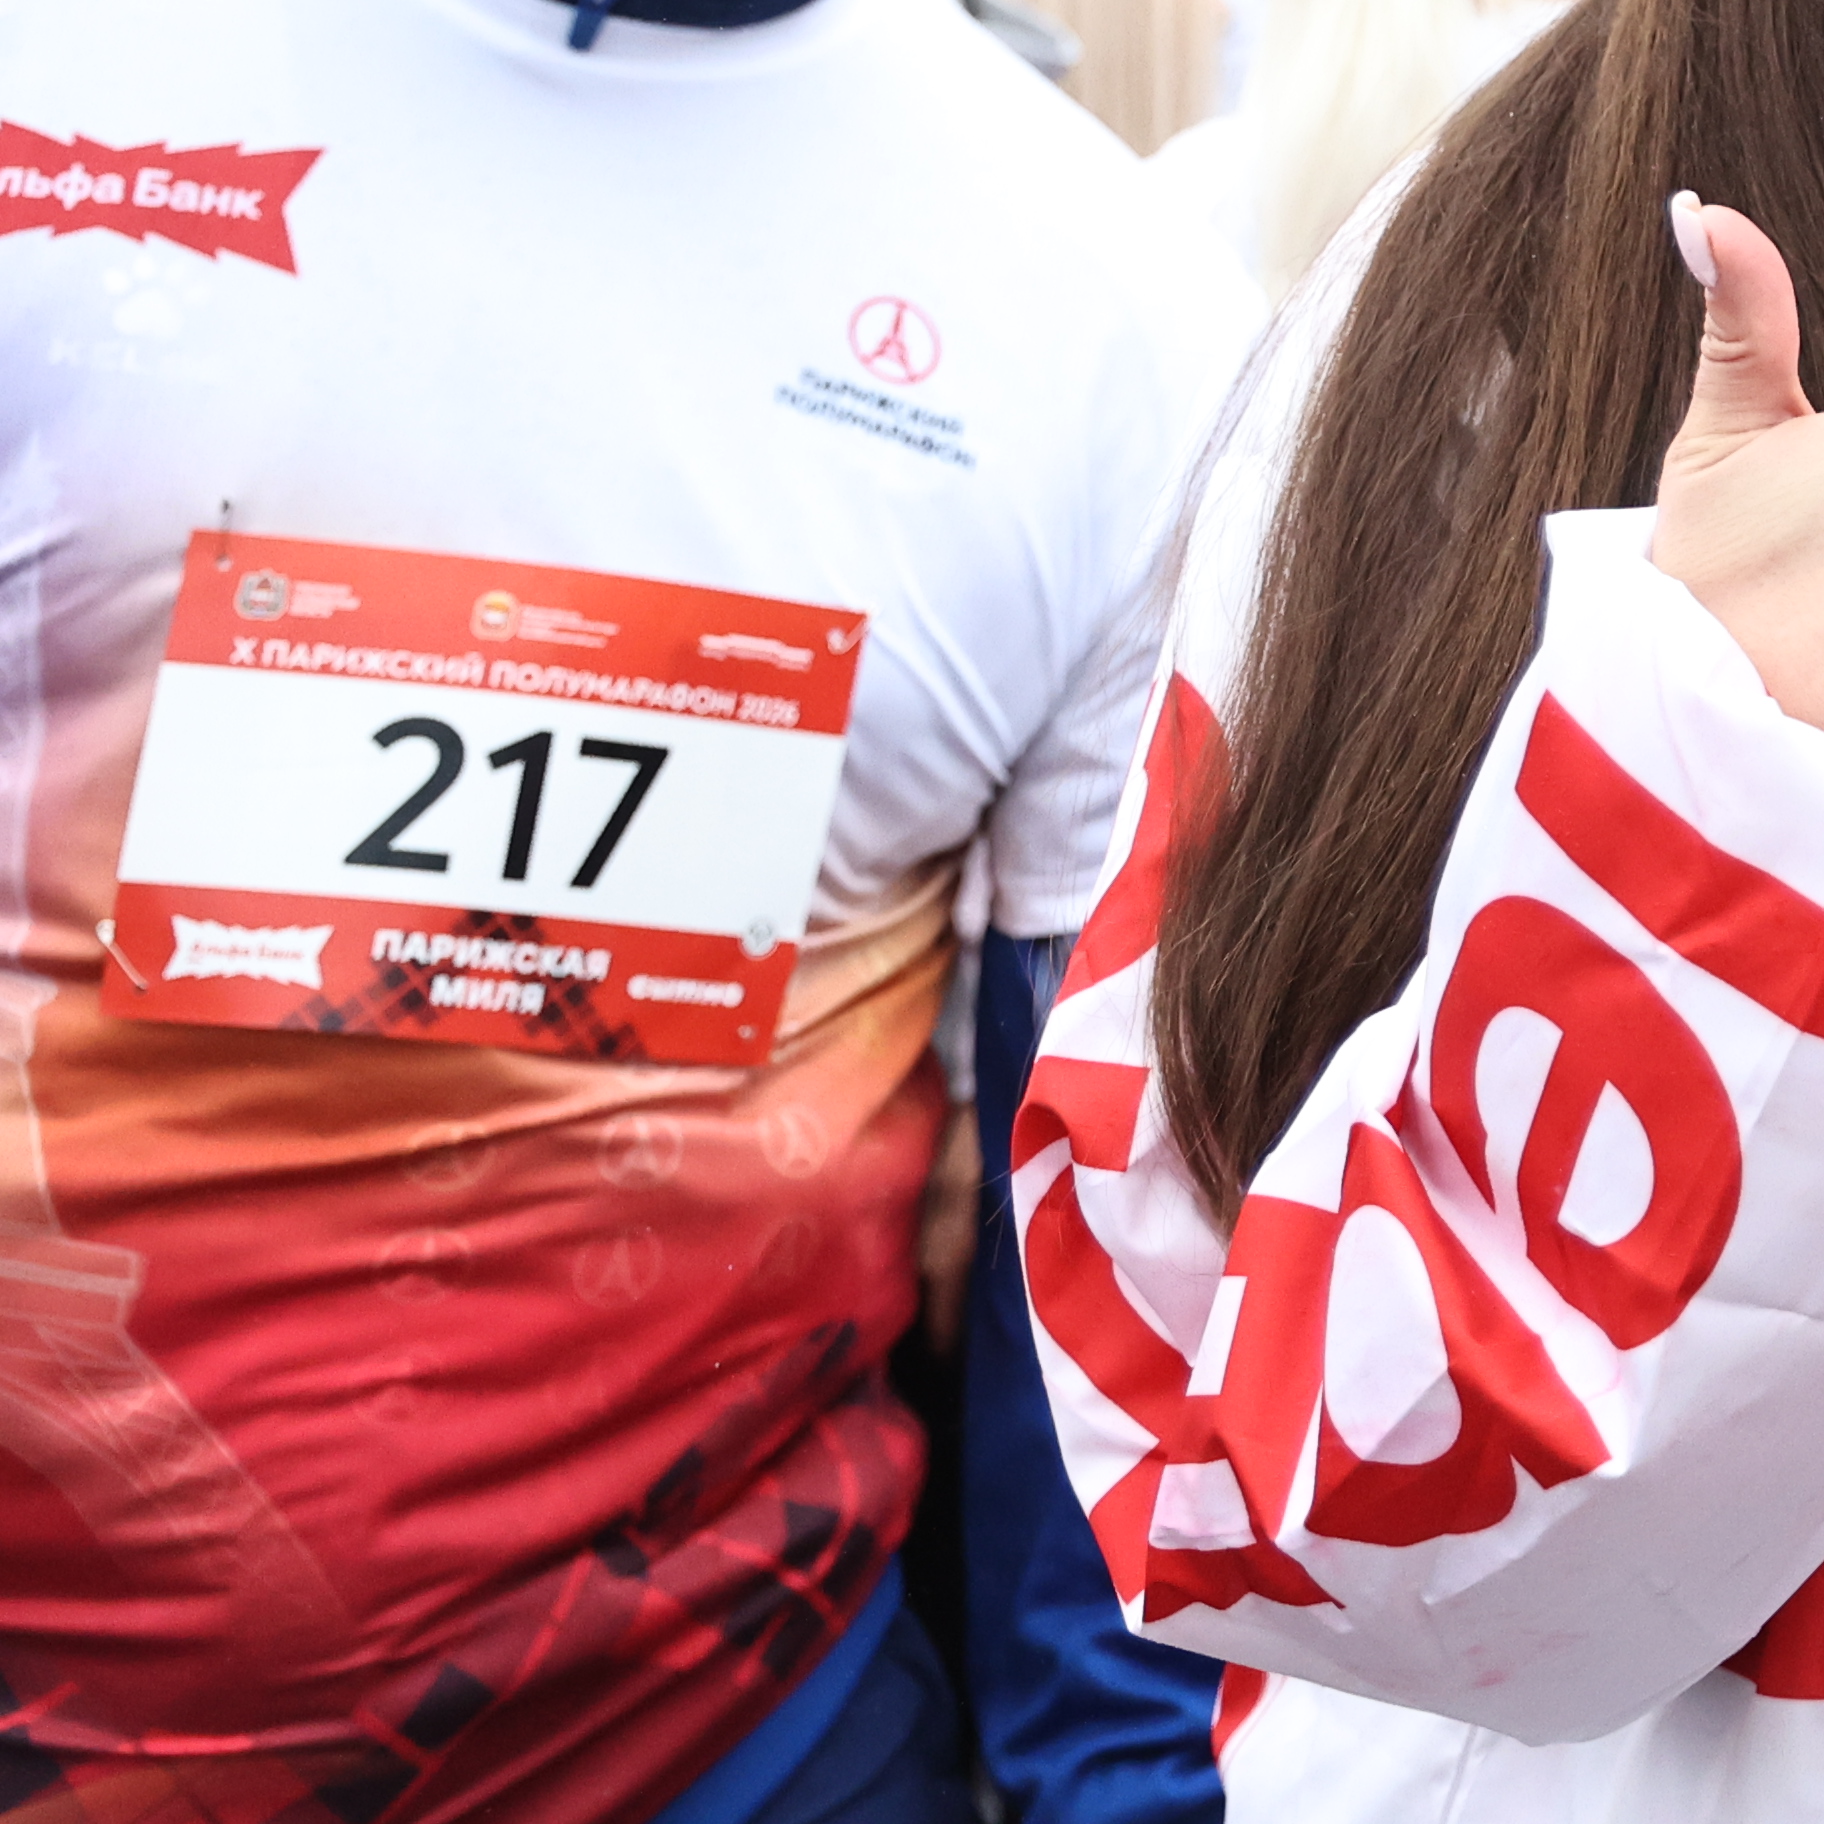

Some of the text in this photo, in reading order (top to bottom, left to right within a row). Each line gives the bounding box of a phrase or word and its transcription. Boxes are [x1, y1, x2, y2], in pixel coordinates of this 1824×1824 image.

[0, 161, 265, 221] льфа Банк
[261, 638, 484, 686] ПАРИЖСКИЙ
[489, 659, 736, 717] ПОЛУМАРАФОН
[344, 716, 668, 889] 217
[371, 928, 611, 982] ПАРИЖСКАЯ
[429, 975, 546, 1017] МИЛЯ
